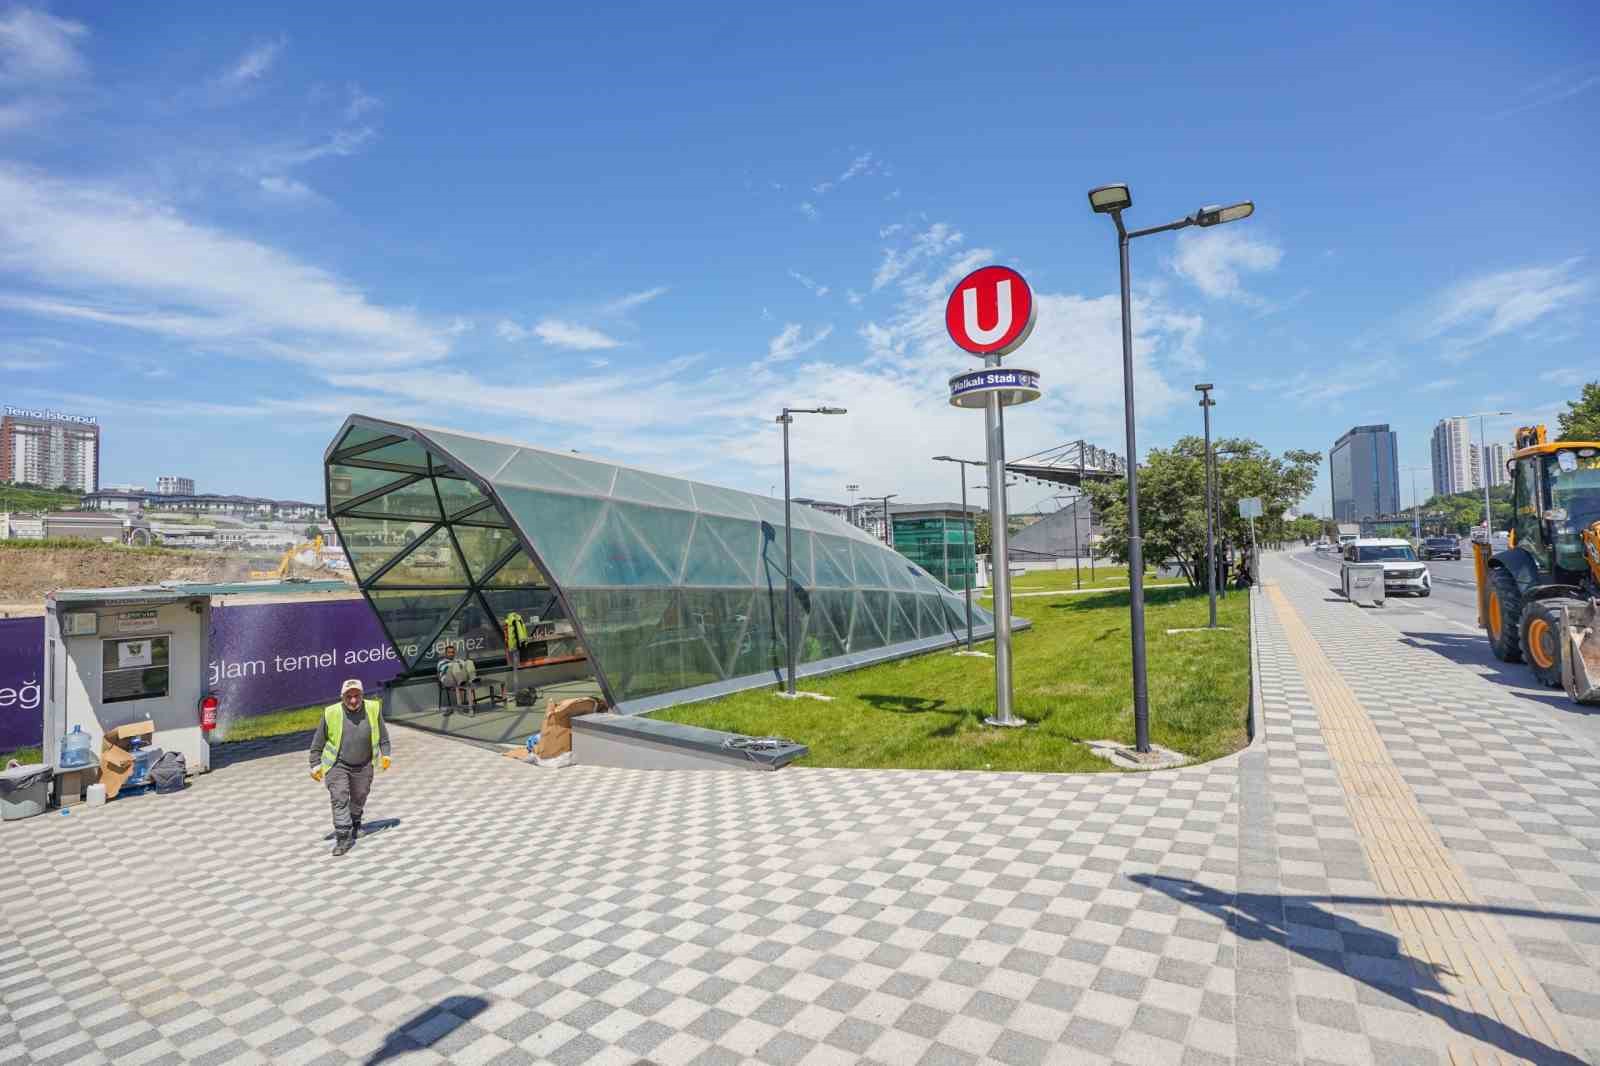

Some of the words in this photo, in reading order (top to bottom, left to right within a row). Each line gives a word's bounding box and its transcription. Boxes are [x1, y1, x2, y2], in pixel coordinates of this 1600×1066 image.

[963, 279, 1013, 345] U
[987, 373, 1016, 385] Stadı
[274, 648, 337, 673] temel
